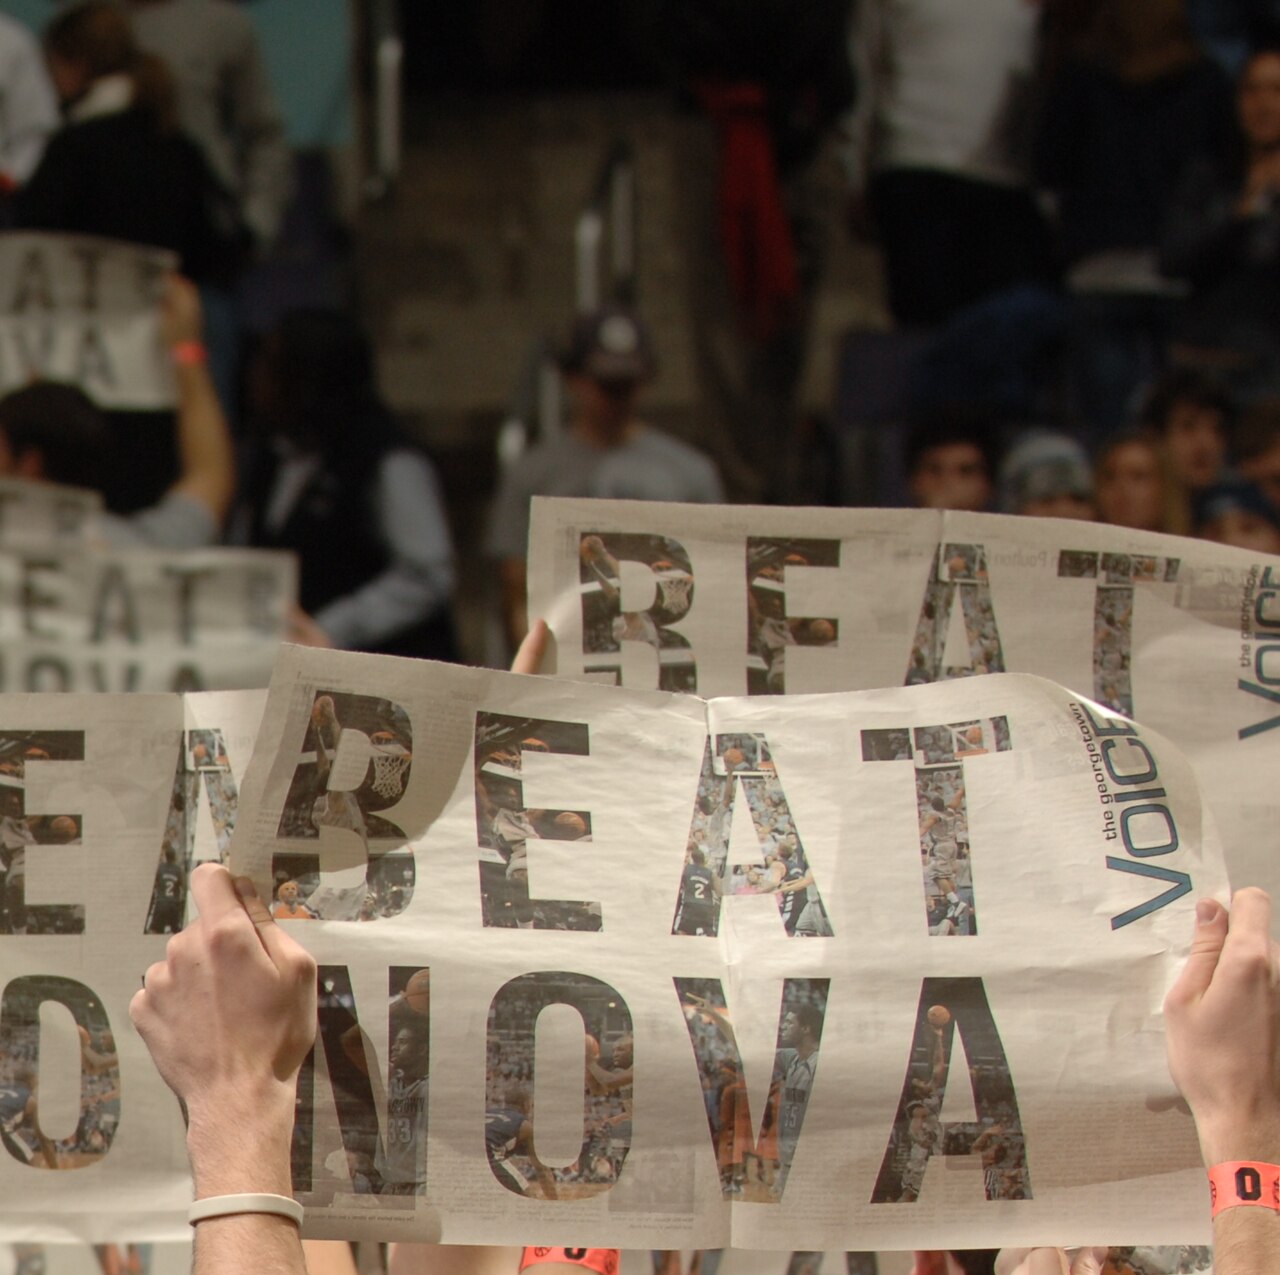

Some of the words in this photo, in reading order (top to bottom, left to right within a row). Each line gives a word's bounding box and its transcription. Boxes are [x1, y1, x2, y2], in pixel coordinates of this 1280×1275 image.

[579, 531, 1182, 718] BEAT
[271, 689, 1014, 938] BEAT
[1069, 701, 1114, 805] georgetown
[1076, 703, 1193, 931] VOICE
[1103, 810, 1118, 841] the
[292, 964, 1035, 1204] NOVA
